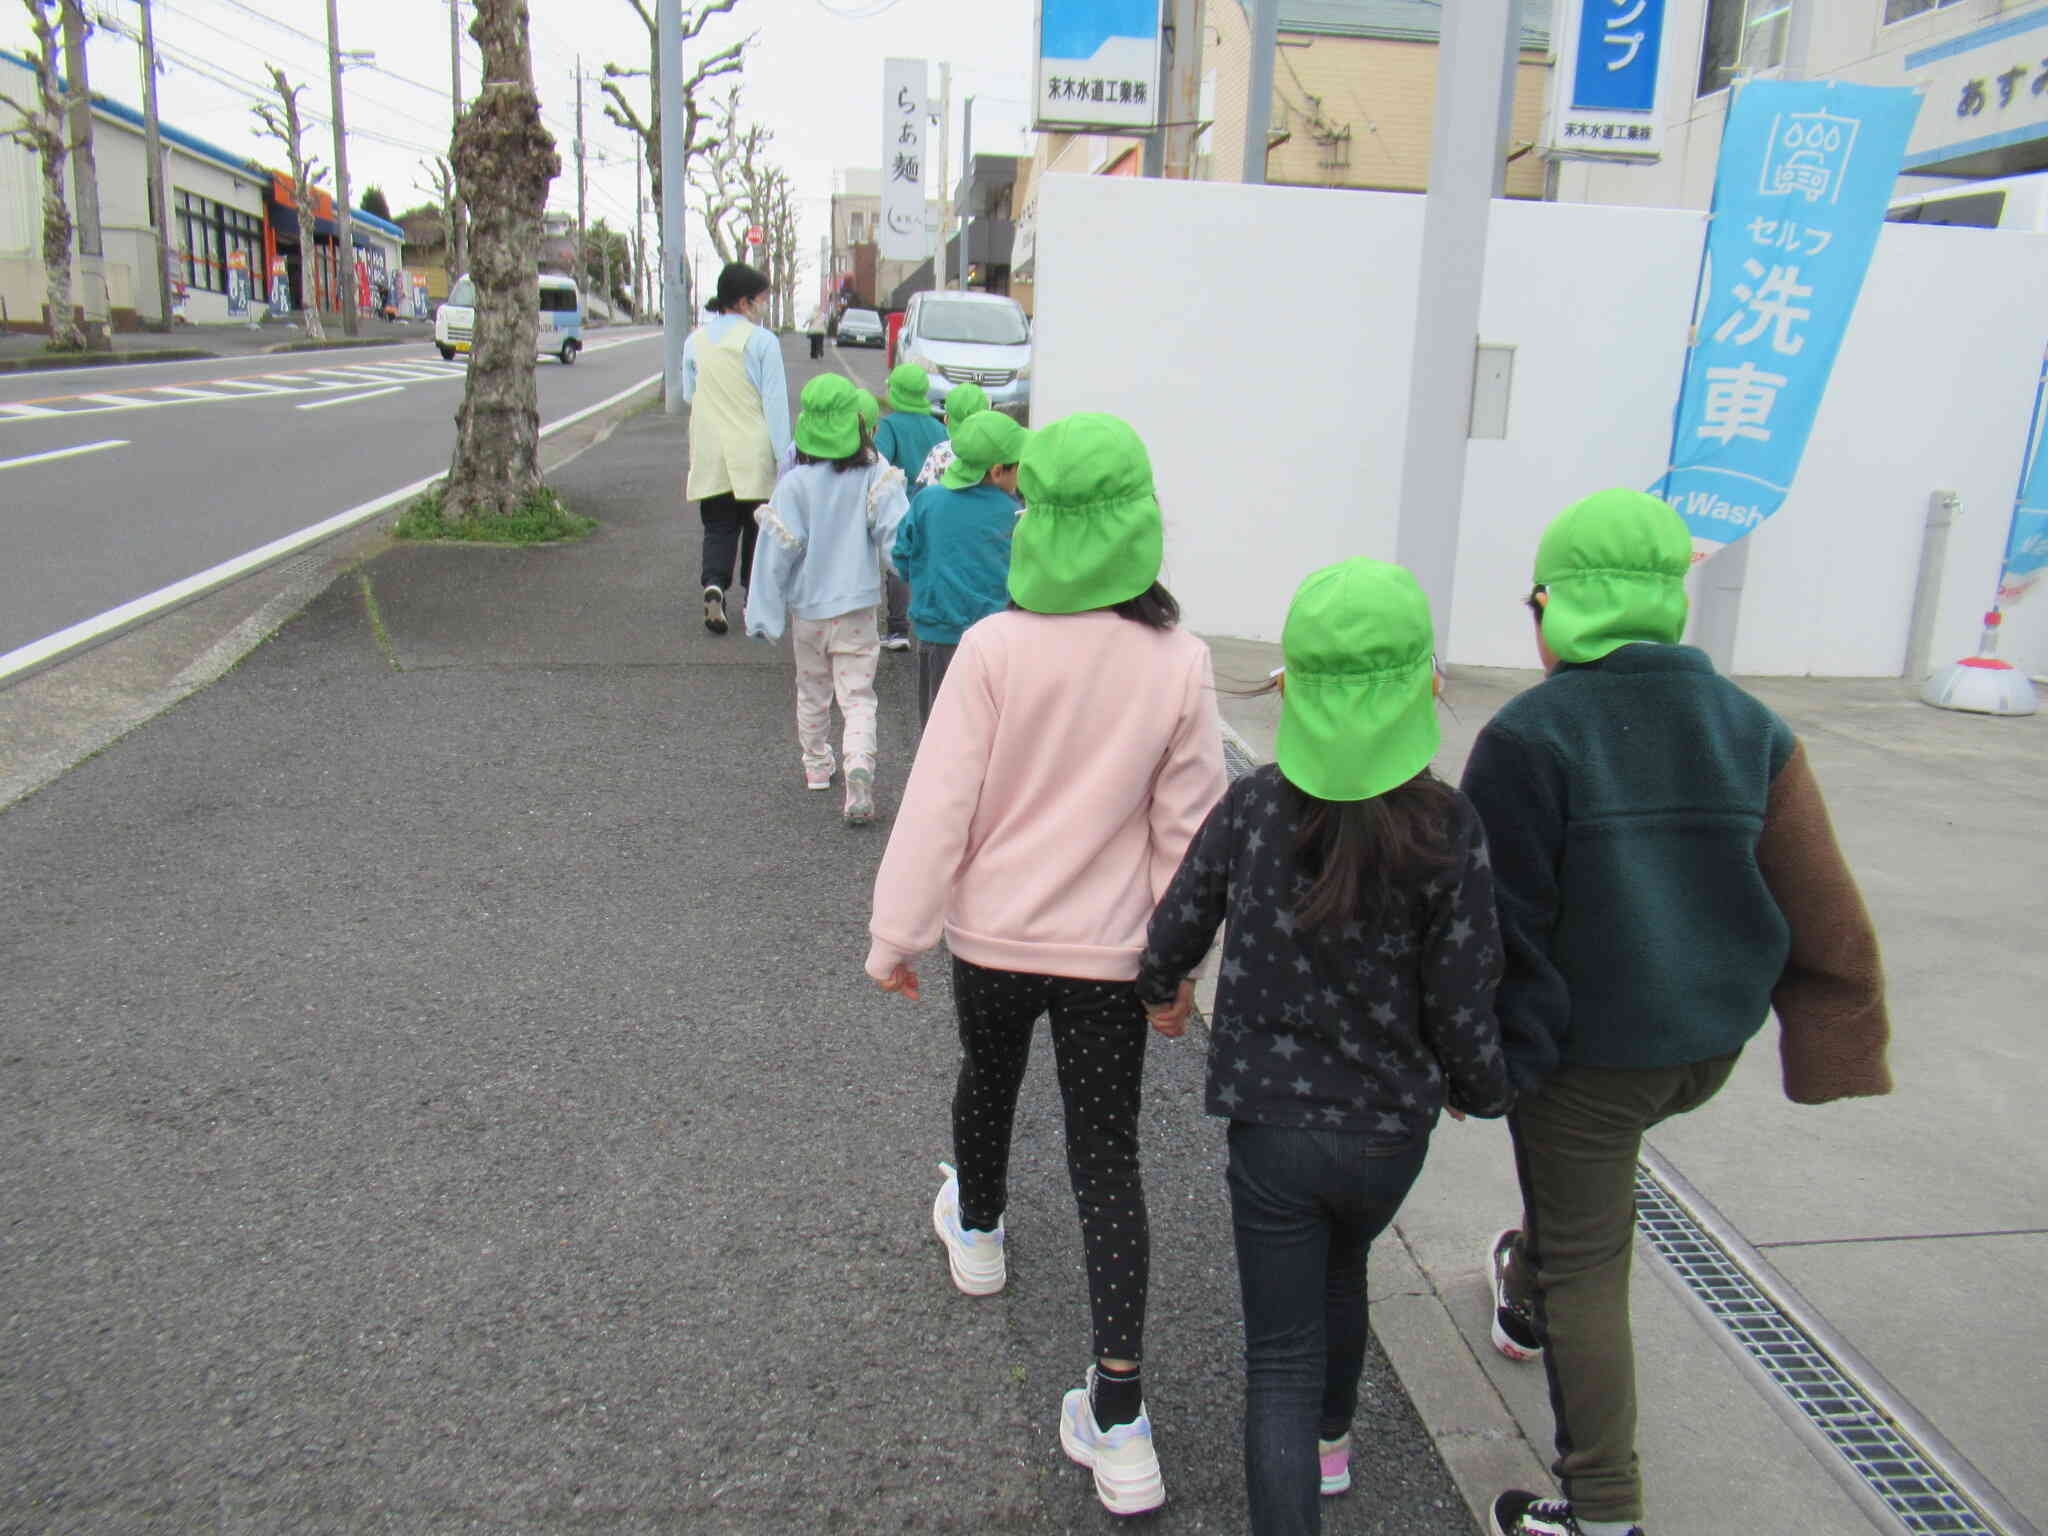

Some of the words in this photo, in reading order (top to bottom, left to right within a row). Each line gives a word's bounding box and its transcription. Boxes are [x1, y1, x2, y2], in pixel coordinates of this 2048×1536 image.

[1745, 215, 1833, 256] セルフ
[1696, 258, 1814, 446] 洗車
[1686, 491, 1762, 529] Wash
